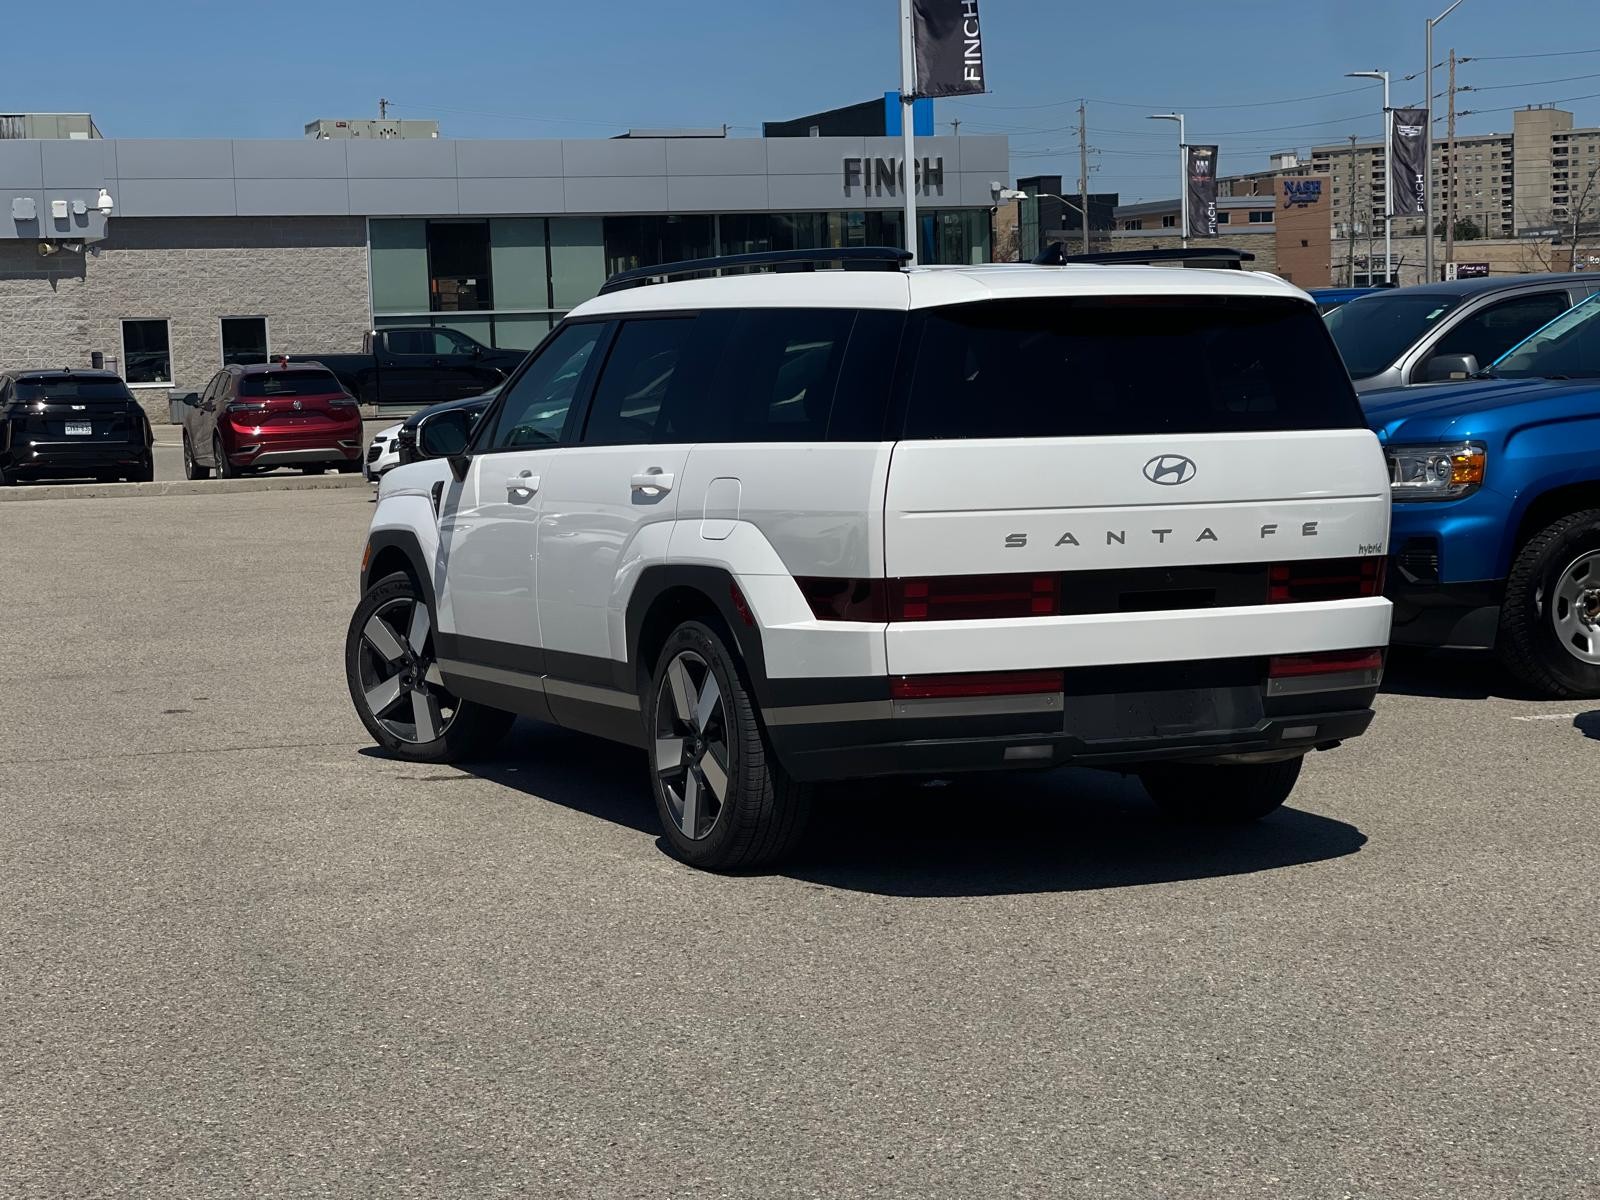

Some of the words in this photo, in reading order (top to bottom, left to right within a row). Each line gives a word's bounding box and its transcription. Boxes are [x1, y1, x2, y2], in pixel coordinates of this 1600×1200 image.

[961, 0, 981, 81] FINCH
[844, 157, 944, 188] FINCH
[1416, 174, 1424, 212] FINCH
[1208, 202, 1216, 234] FINCH
[1005, 527, 1218, 548] SANTA
[1260, 521, 1318, 539] FE
[1358, 543, 1382, 557] hybrid
